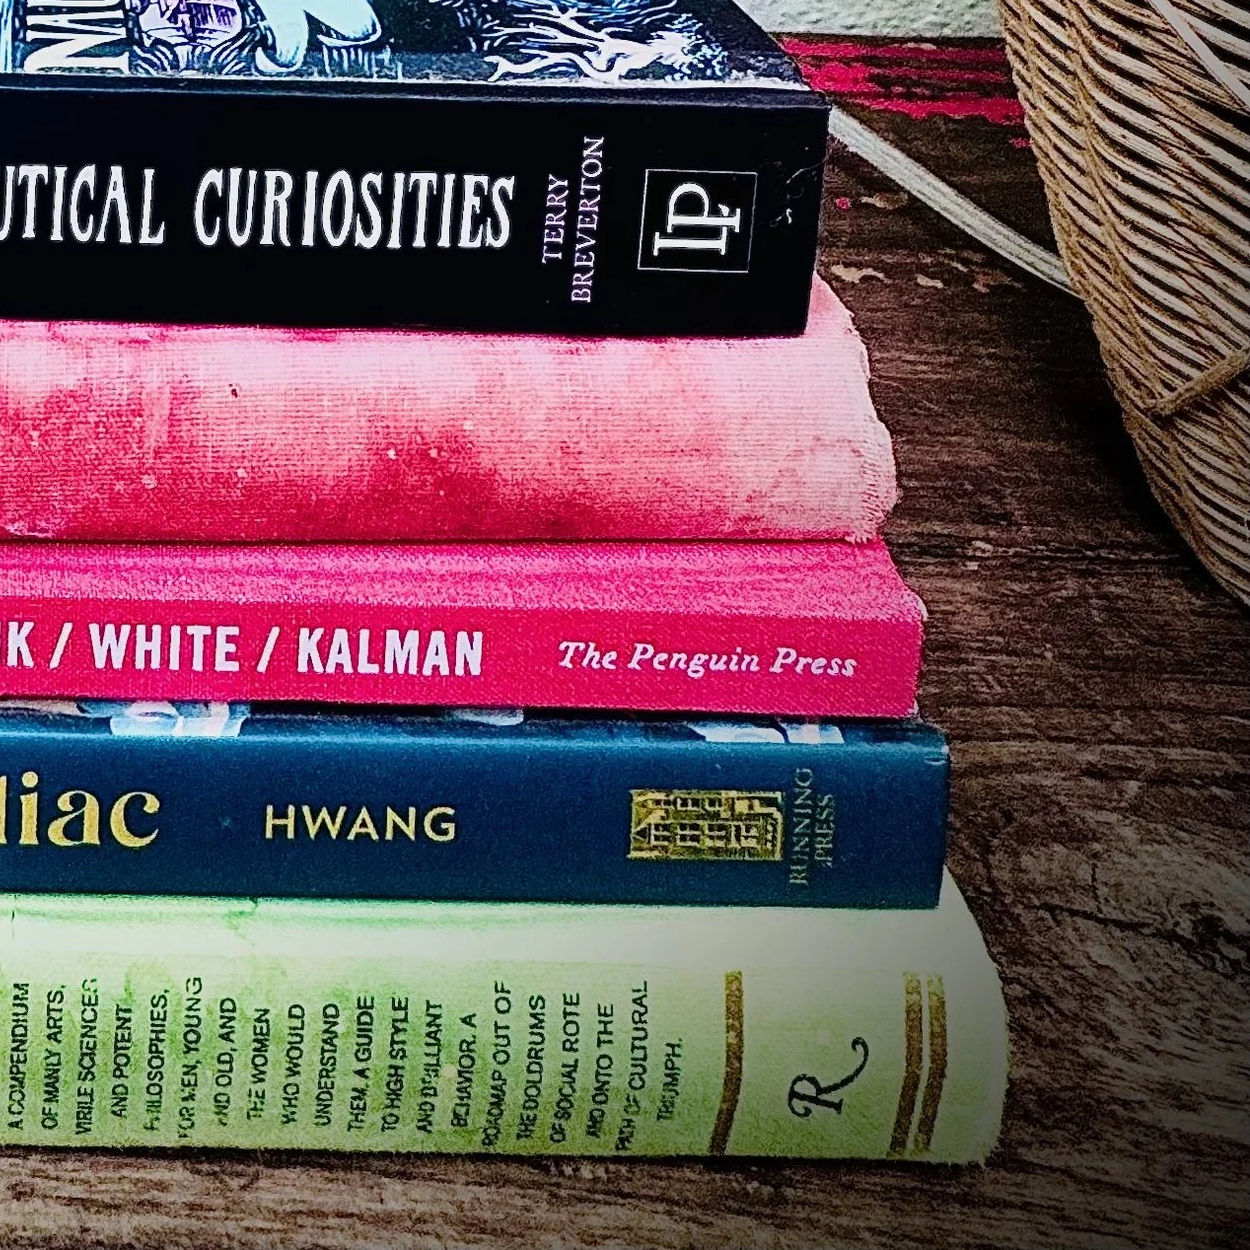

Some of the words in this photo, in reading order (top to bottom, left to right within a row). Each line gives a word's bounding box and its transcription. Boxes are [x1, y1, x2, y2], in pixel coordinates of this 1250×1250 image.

[194, 168, 515, 249] CURIOSITIES
[542, 173, 569, 264] TERRY
[571, 136, 605, 303] BREVERTON
[89, 622, 240, 671] WHITE
[297, 627, 483, 676] KALMAN
[558, 641, 617, 669] The
[627, 643, 760, 678] Penguin
[770, 647, 858, 677] Press
[264, 804, 456, 843] HWANG
[789, 767, 813, 885] RUNNING
[814, 793, 836, 861] PRESS
[183, 976, 202, 1055] YOUNG
[218, 997, 237, 1044] AND
[459, 1012, 477, 1029] A
[494, 980, 511, 1014] OF
[562, 992, 581, 1053] ROTE
[596, 1002, 614, 1048] THE
[8, 982, 30, 1116] COMPENDIUM
[113, 1003, 132, 1079] POTENT
[251, 1008, 271, 1084] WOMEN
[286, 1003, 306, 1078] WOULD
[354, 995, 375, 1062] GUIDE
[389, 996, 409, 1060] STYLE
[493, 1020, 511, 1065] OUT
[521, 994, 546, 1111] DOLDRUMS
[628, 980, 649, 1091] CULTURAL
[43, 1047, 62, 1104] MANLY
[313, 1002, 340, 1127] UNDERSTAND
[352, 1067, 369, 1080] A
[385, 1064, 406, 1109] HIGH
[554, 1058, 579, 1121] SOCIAL
[591, 1054, 614, 1105] ONTO
[787, 1036, 869, 1118] R
[8, 1118, 24, 1131] A
[41, 1105, 59, 1130] OF
[75, 1086, 95, 1135] VIRILE
[111, 1083, 129, 1118] AND
[281, 1082, 300, 1125] WHO
[380, 1112, 400, 1133] TO
[416, 1100, 435, 1134] AND
[516, 1112, 538, 1141] THE
[550, 1122, 567, 1144] OF
